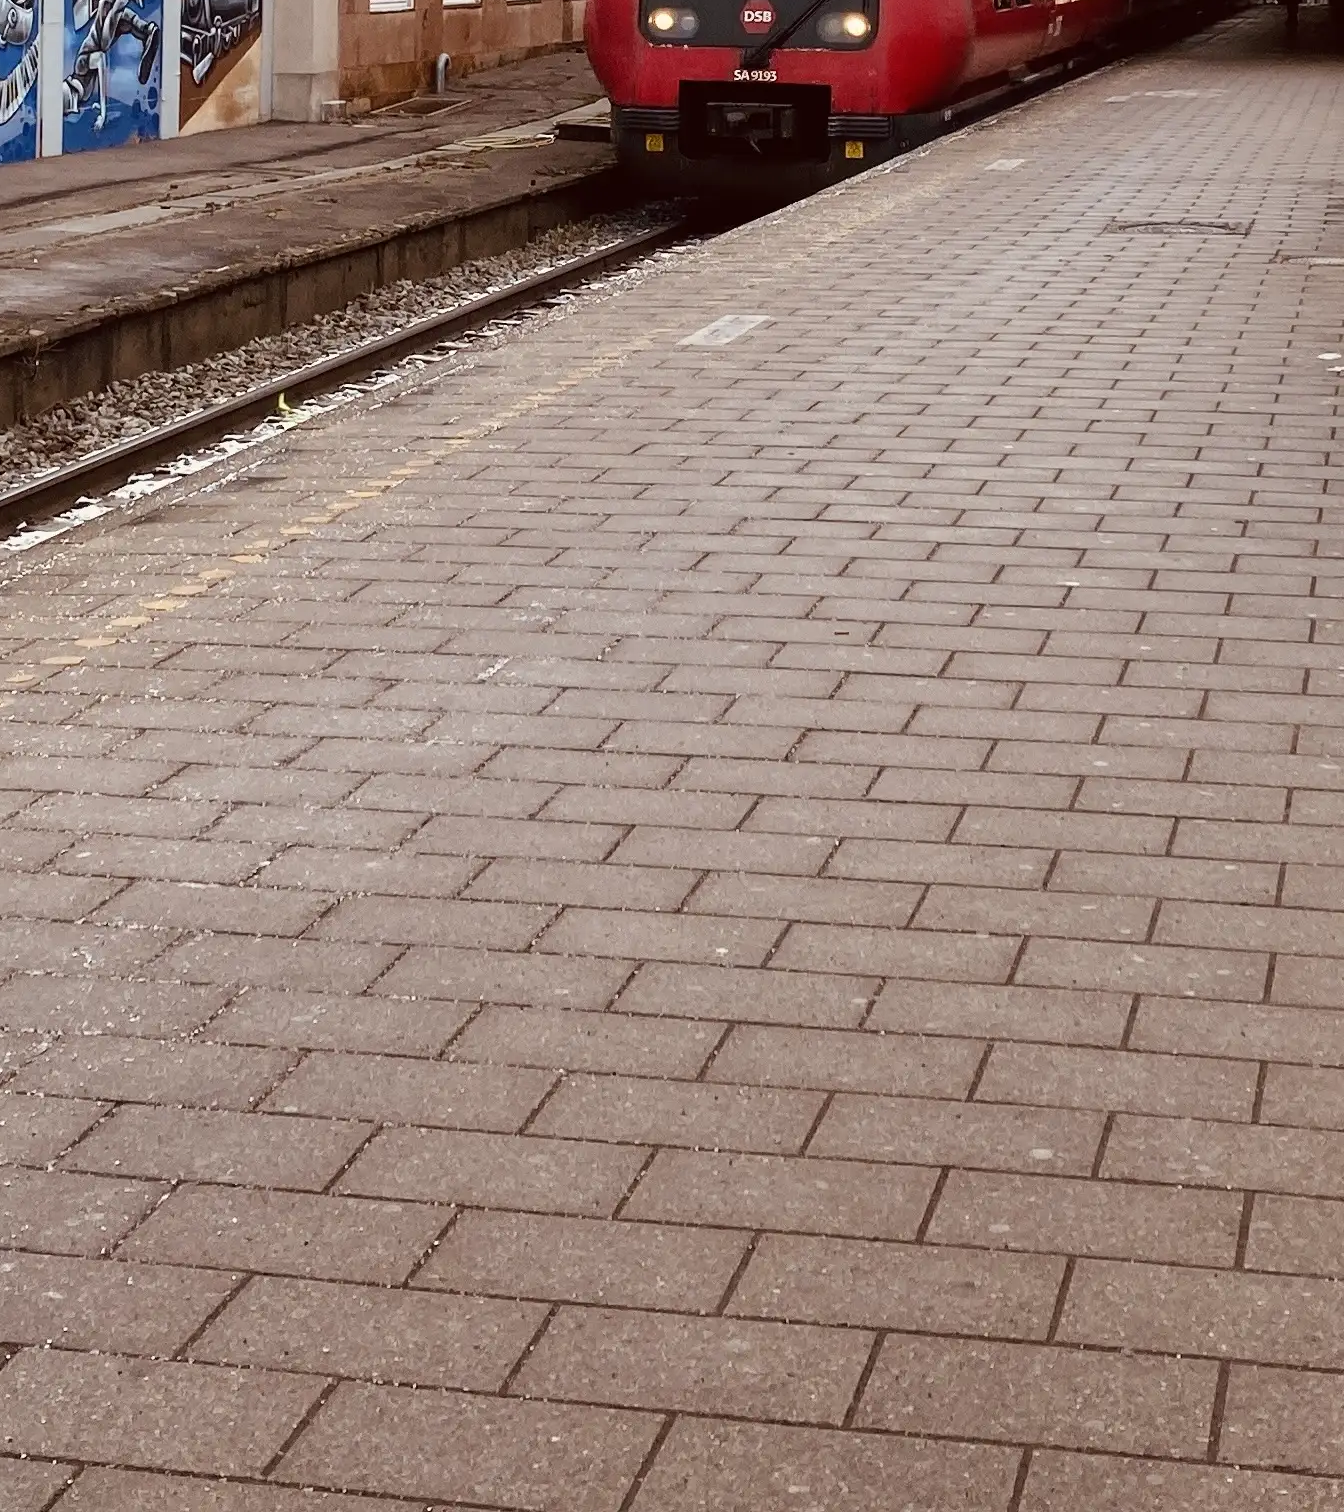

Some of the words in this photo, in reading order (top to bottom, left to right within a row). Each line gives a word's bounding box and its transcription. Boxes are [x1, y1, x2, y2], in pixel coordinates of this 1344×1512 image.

[744, 10, 772, 23] DSB
[733, 69, 750, 81] SA
[751, 70, 777, 82] 9193
